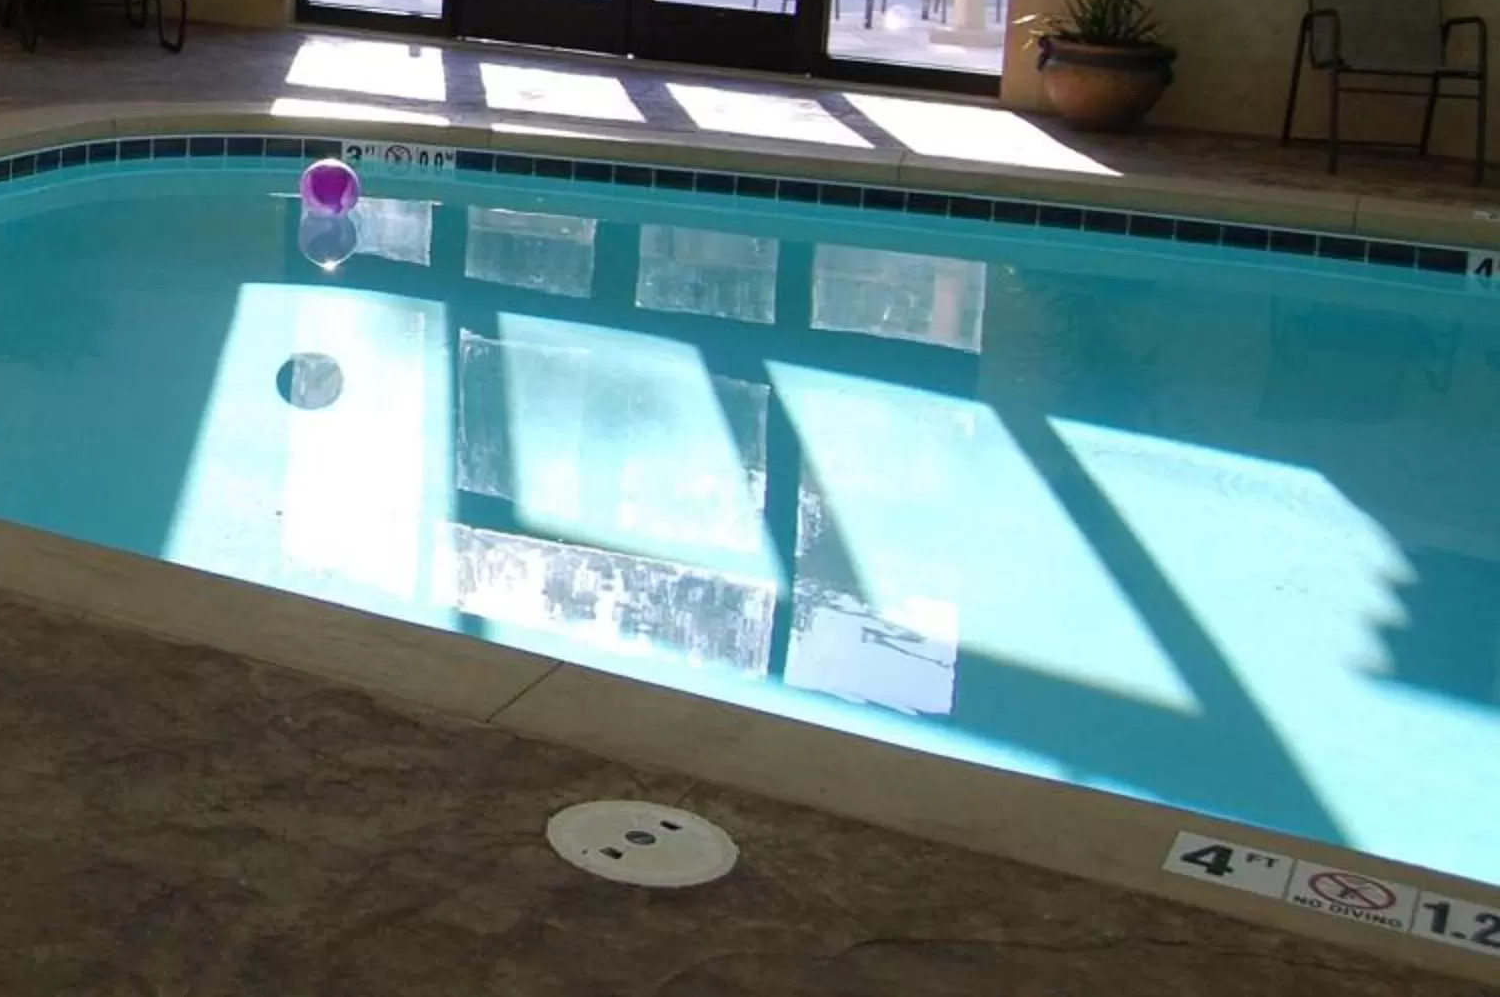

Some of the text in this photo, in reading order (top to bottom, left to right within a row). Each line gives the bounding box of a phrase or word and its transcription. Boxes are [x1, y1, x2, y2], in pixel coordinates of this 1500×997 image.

[1180, 843, 1281, 876] 4 FT
[1293, 895, 1403, 928] NO DIVING
